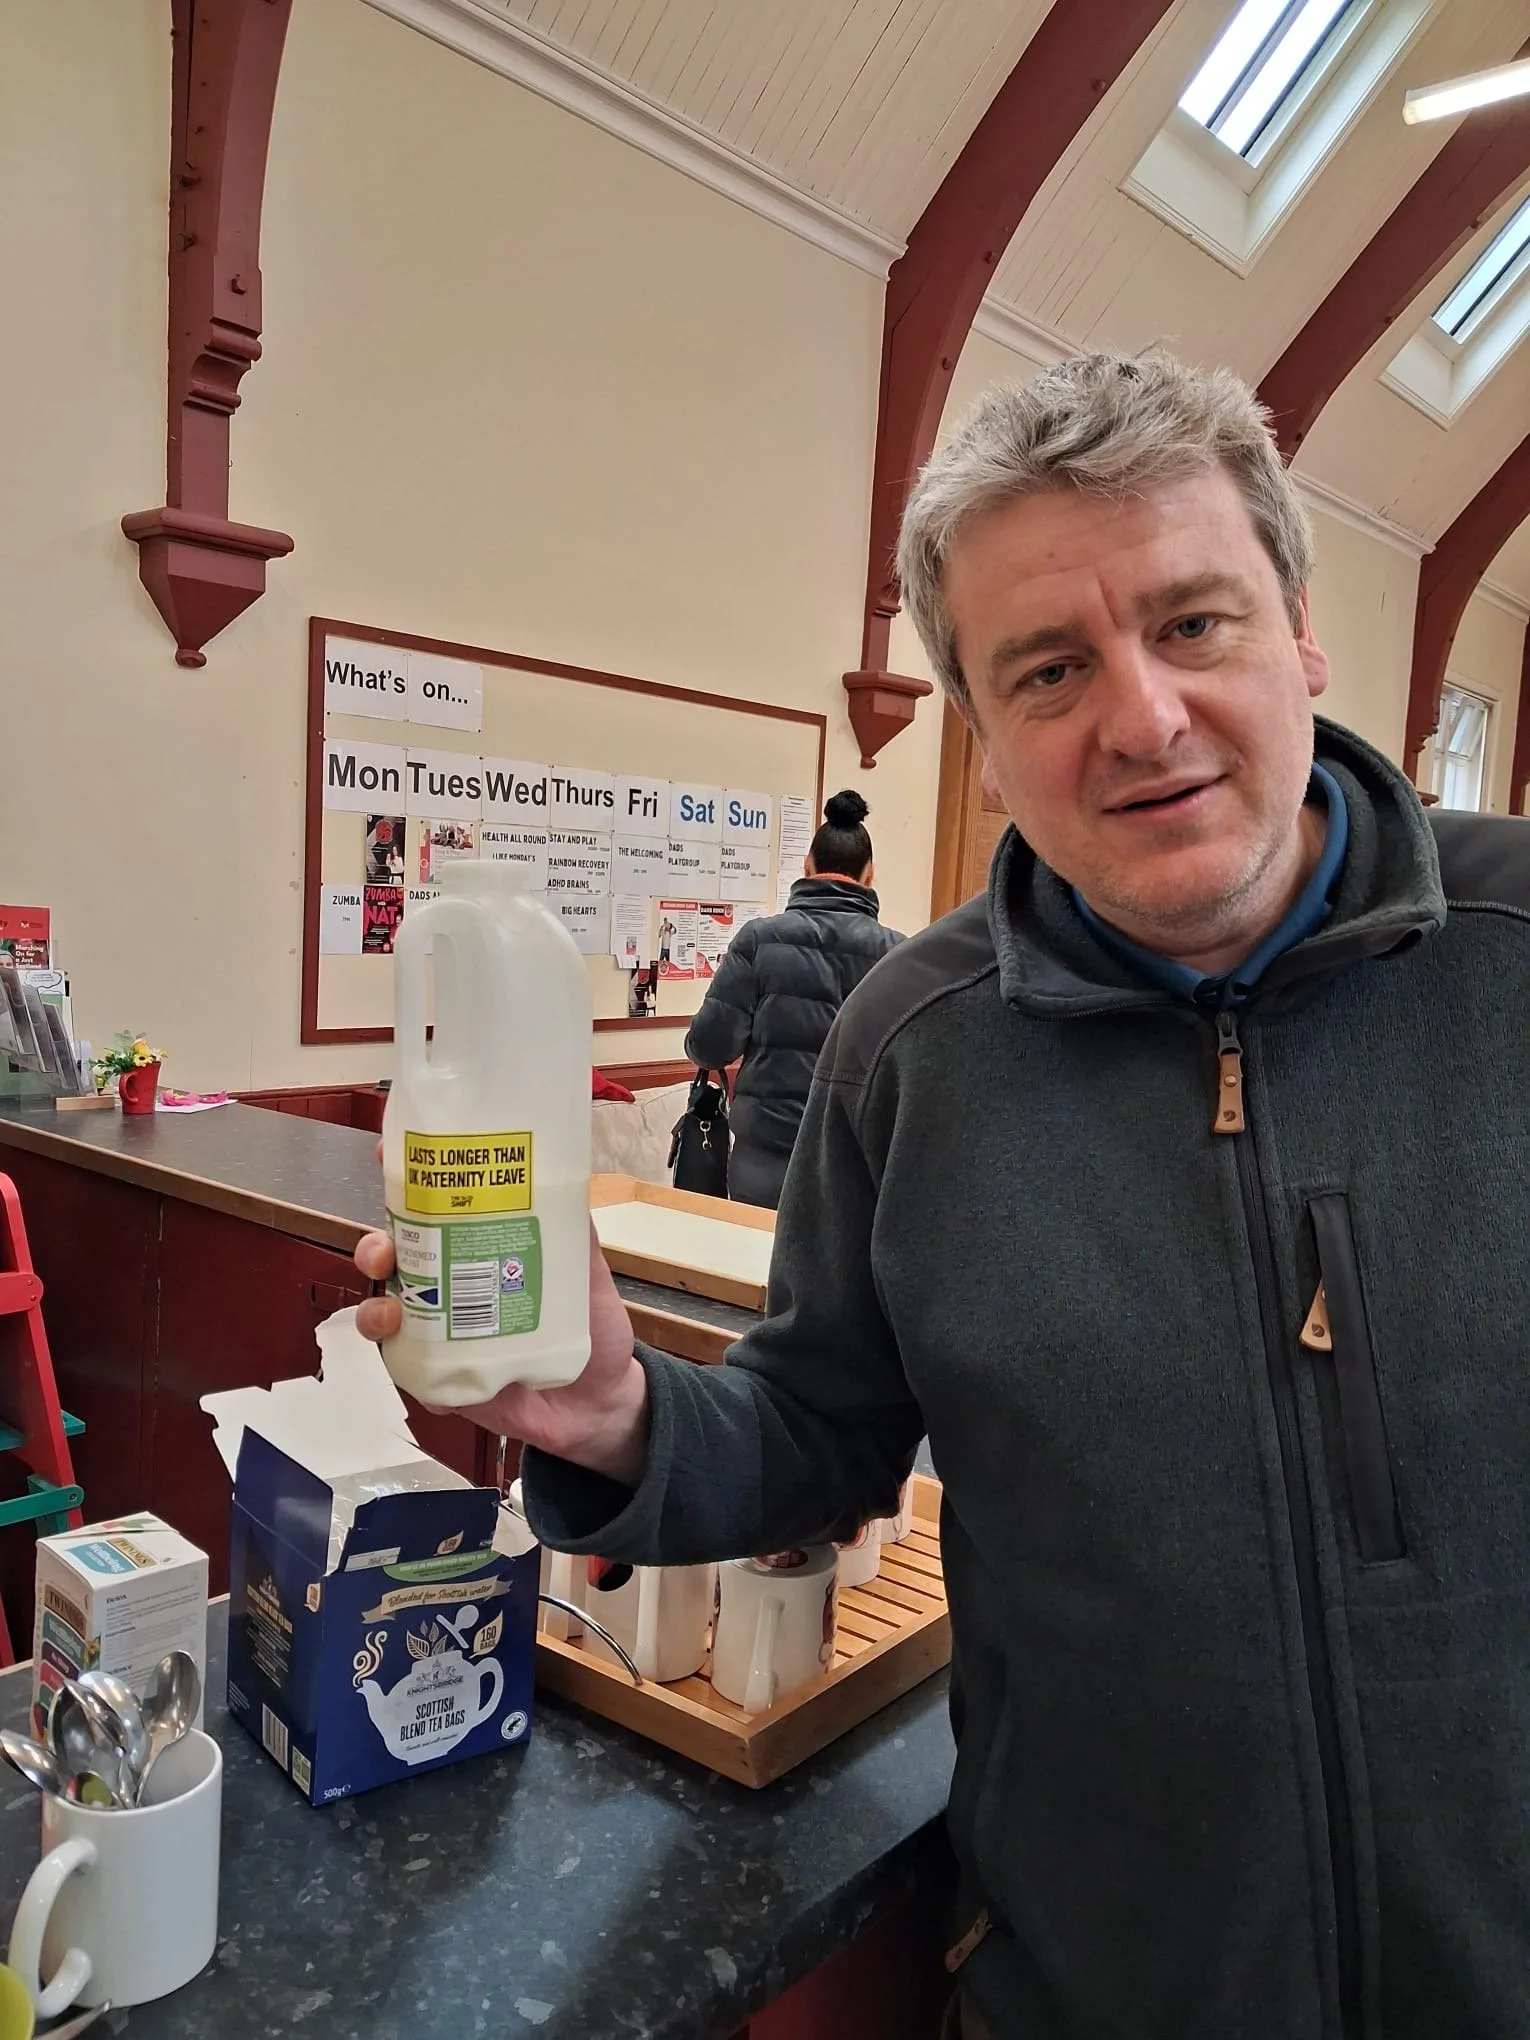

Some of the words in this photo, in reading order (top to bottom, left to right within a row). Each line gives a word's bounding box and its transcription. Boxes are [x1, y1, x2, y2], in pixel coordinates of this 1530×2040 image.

[326, 660, 406, 693] What's
[422, 680, 468, 704] on...
[328, 753, 400, 792] Mon
[406, 761, 482, 800] Tues
[485, 771, 547, 806] Wed
[551, 778, 614, 808] Thurs
[628, 788, 658, 818] Fri
[680, 794, 715, 824] Sat
[728, 800, 767, 830] Sun
[482, 831, 508, 843] HEALTH
[510, 833, 522, 843] ALL
[523, 834, 547, 845] ROUND
[549, 834, 566, 843] STAY
[567, 835, 580, 845] AND
[581, 837, 597, 846] PLAY
[618, 847, 629, 857] THE
[630, 848, 664, 859] WELCOMING
[668, 843, 684, 852] DADS
[721, 847, 735, 856] DADS
[495, 853, 508, 861] LIKE
[509, 854, 536, 862] MONDAY'S
[548, 857, 577, 868] RAINBOW
[578, 860, 609, 870] RECOVERY
[668, 857, 700, 868] PLAYGROUP
[721, 861, 750, 871] PLAYGROUP
[547, 879, 566, 888] ADHD
[567, 880, 590, 888] BRAINS
[332, 895, 361, 906] ZUMBA
[366, 887, 396, 902] ZUMBA
[409, 890, 430, 900] DADS
[366, 906, 398, 925] NAT
[561, 906, 572, 915] BIG
[573, 906, 598, 916] HEARTS
[409, 1146, 436, 1166] LASTS
[440, 1148, 490, 1166] LONGER
[494, 1146, 525, 1164] THAN
[421, 1170, 485, 1188] PATERNITY
[489, 1168, 525, 1186] LEAVE
[481, 1625, 497, 1642] 160
[480, 1640, 497, 1651] BAGS
[415, 1695, 455, 1721] SCOTTISH
[400, 1720, 426, 1742] BLEND
[428, 1715, 442, 1733] TEA
[444, 1709, 466, 1729] BAGS
